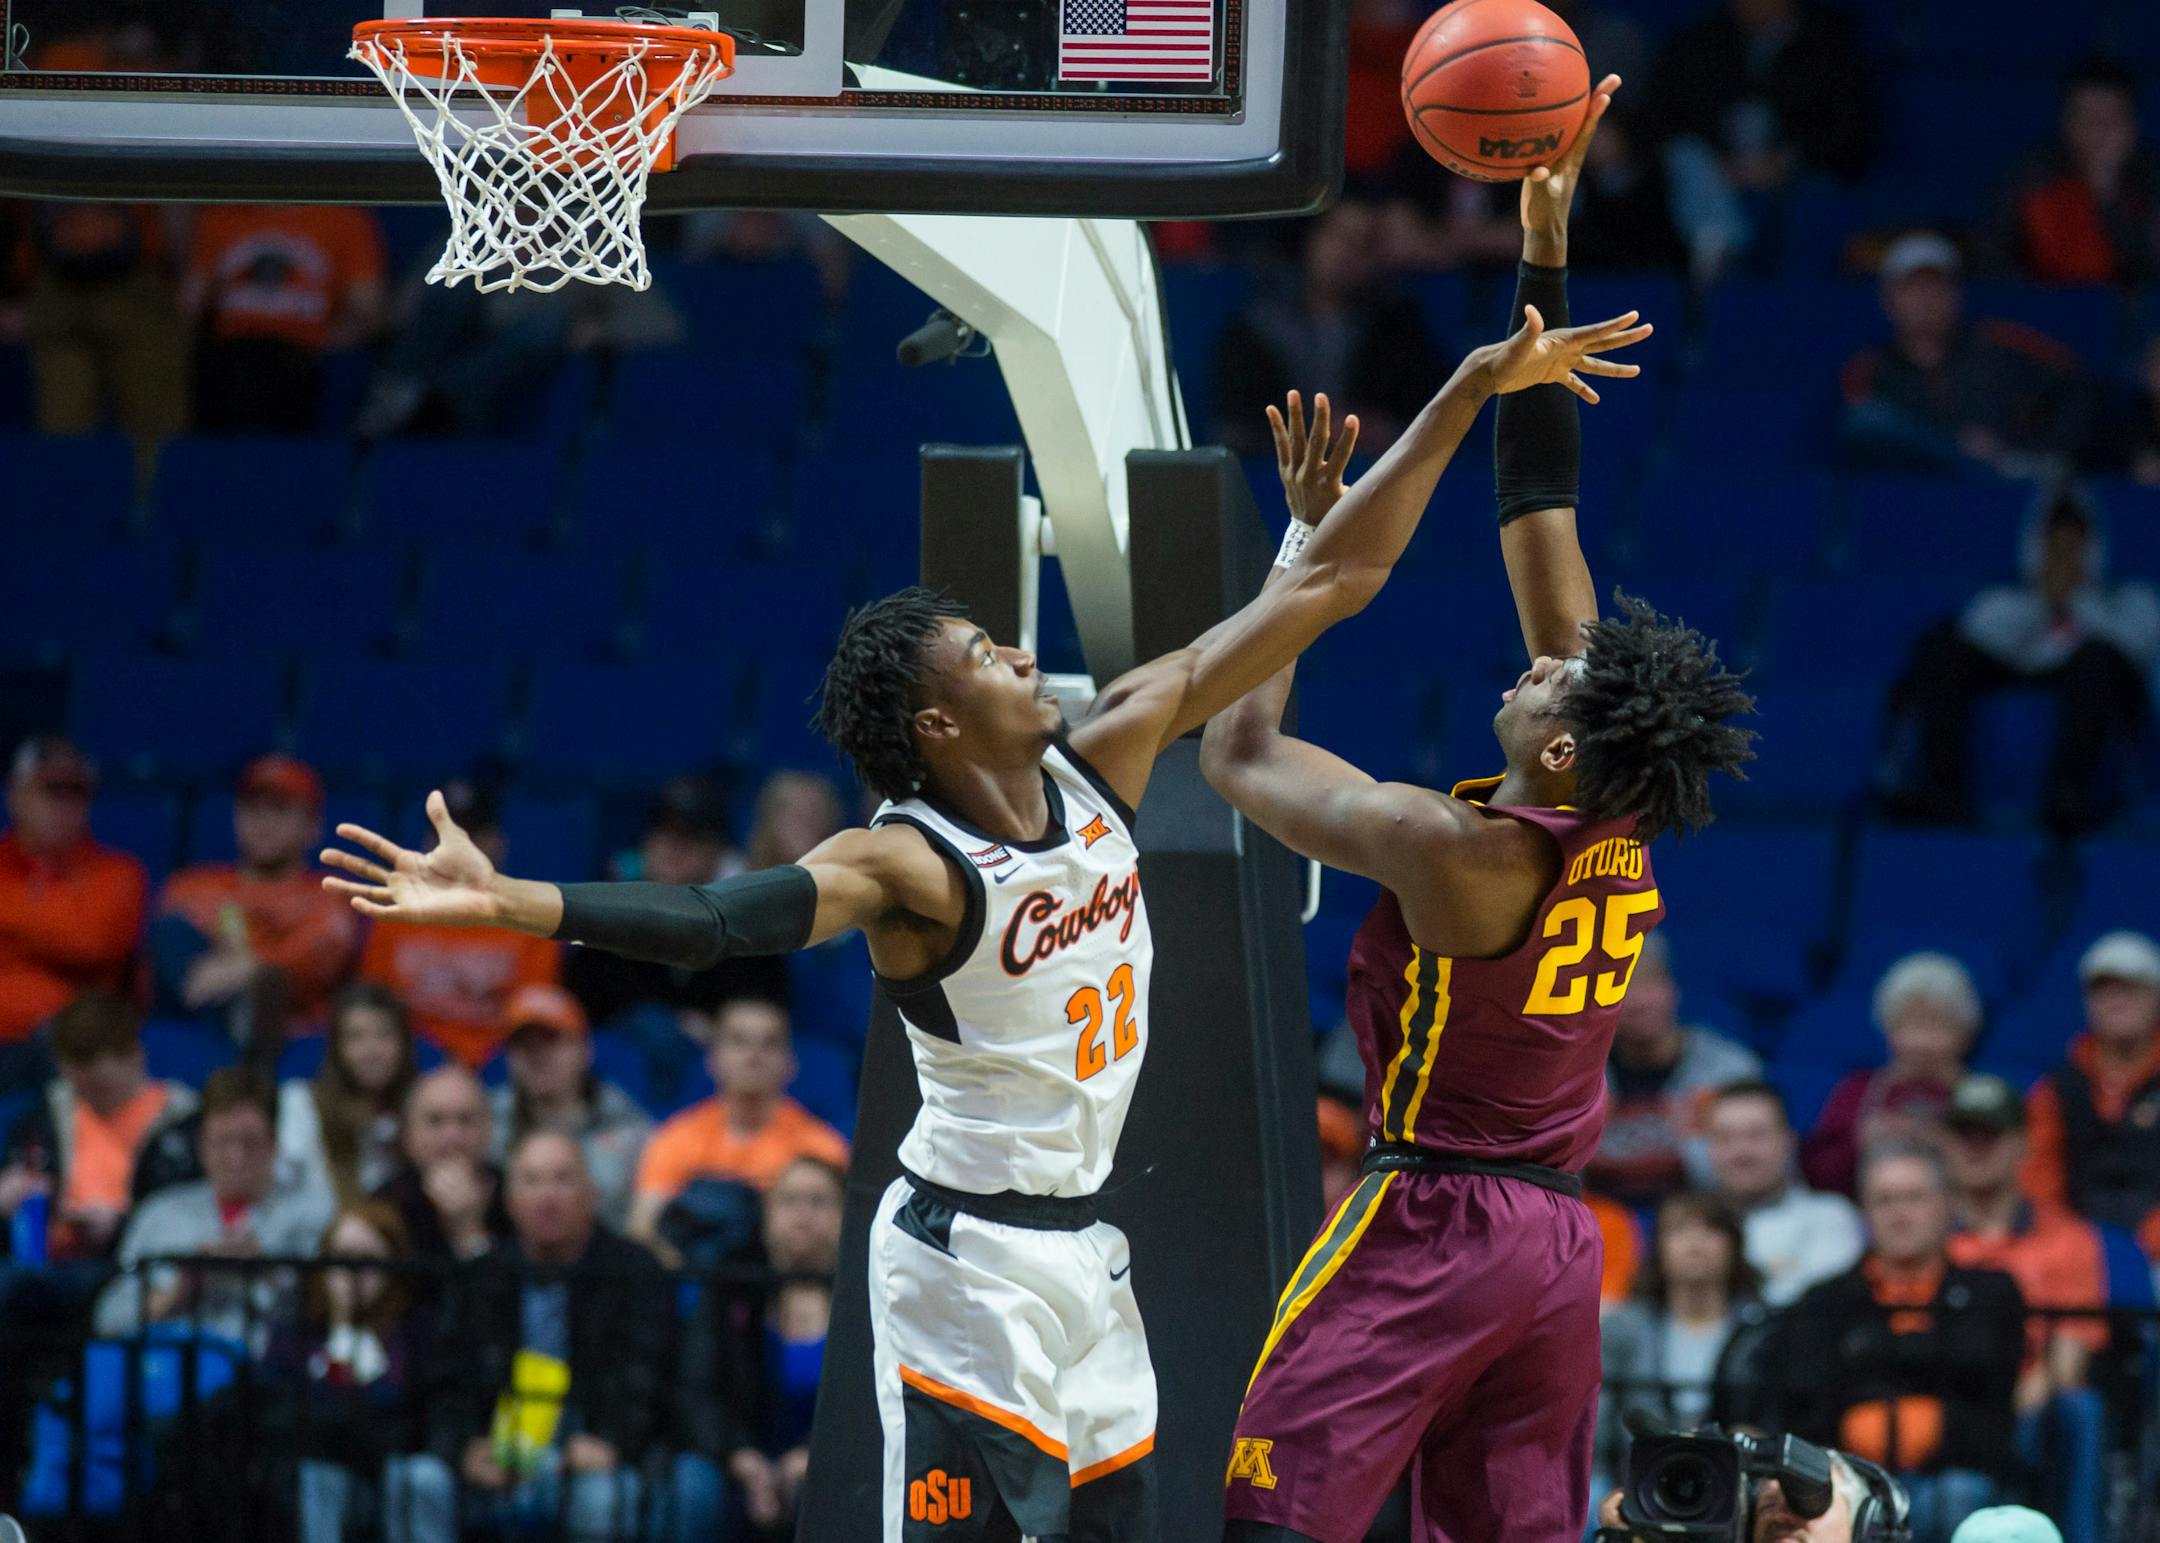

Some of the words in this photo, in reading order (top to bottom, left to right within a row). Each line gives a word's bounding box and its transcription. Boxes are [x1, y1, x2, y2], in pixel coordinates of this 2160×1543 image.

[1479, 128, 1565, 159] NCAA
[971, 846, 1008, 865] OONE
[1000, 871, 1139, 977] Cowboy
[1521, 888, 1659, 1015] 25
[1064, 963, 1138, 1082] 22
[1226, 1437, 1278, 1490] M
[910, 1469, 972, 1525] OSU
